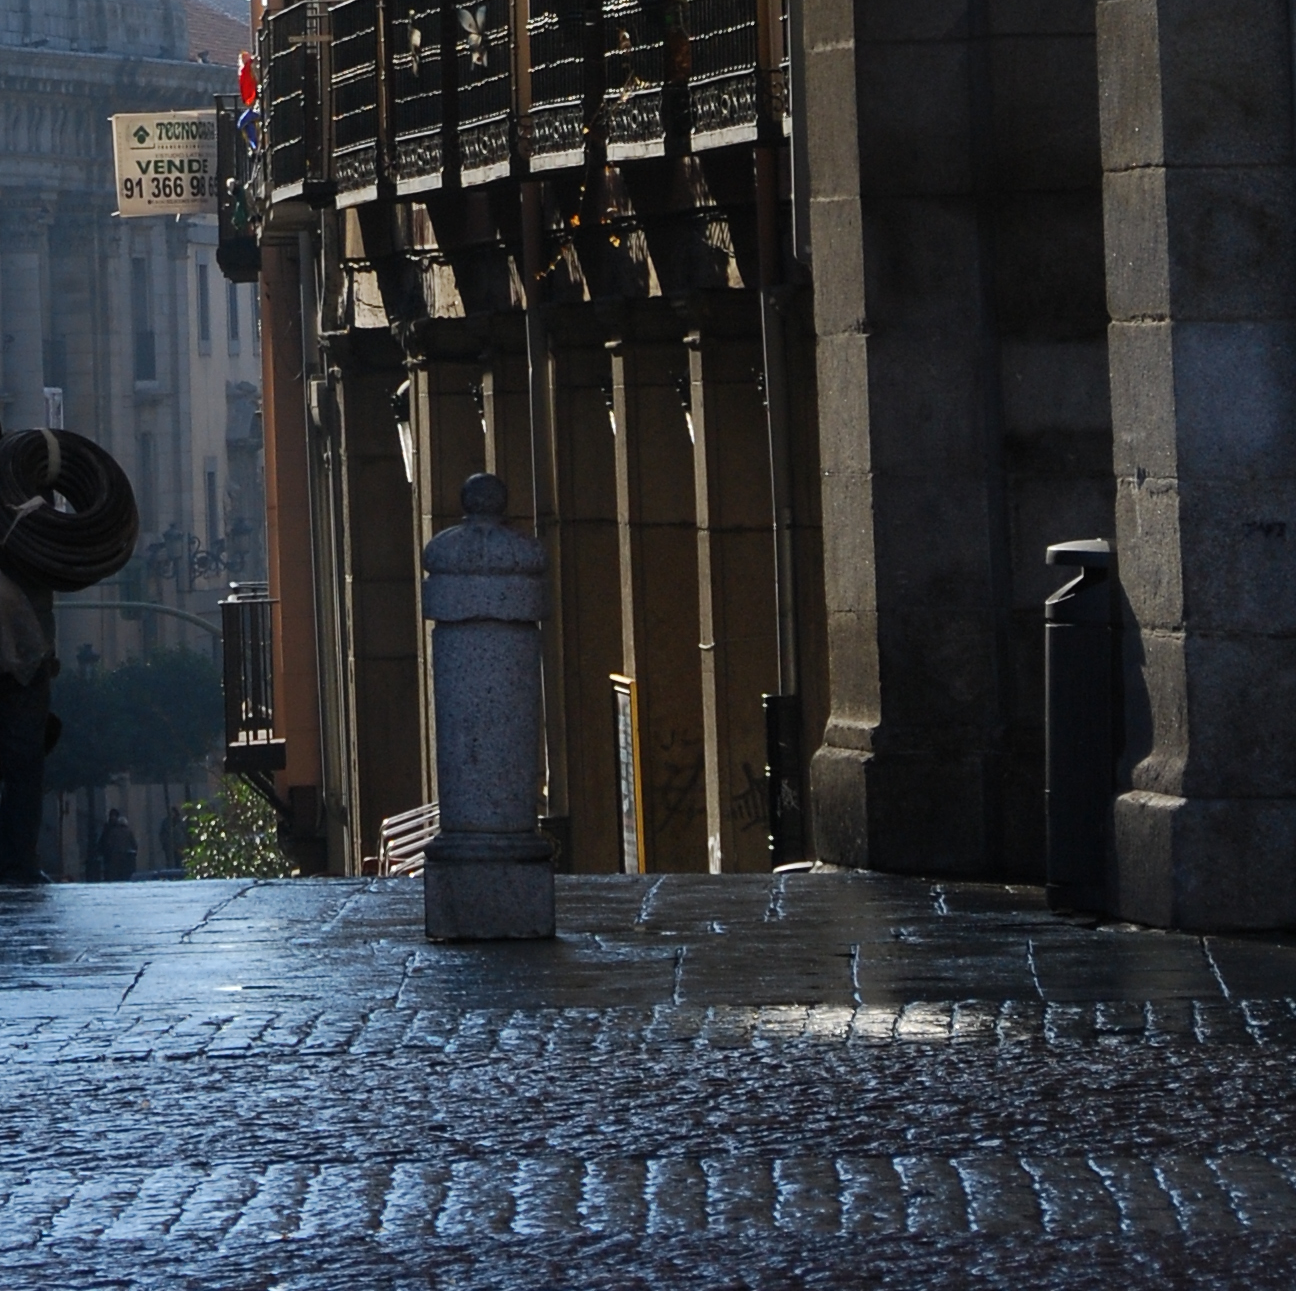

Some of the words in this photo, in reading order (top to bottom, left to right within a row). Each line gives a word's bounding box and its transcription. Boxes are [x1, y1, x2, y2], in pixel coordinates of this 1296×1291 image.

[135, 159, 208, 175] VENDE
[124, 177, 144, 199] 91
[151, 176, 184, 198] 366
